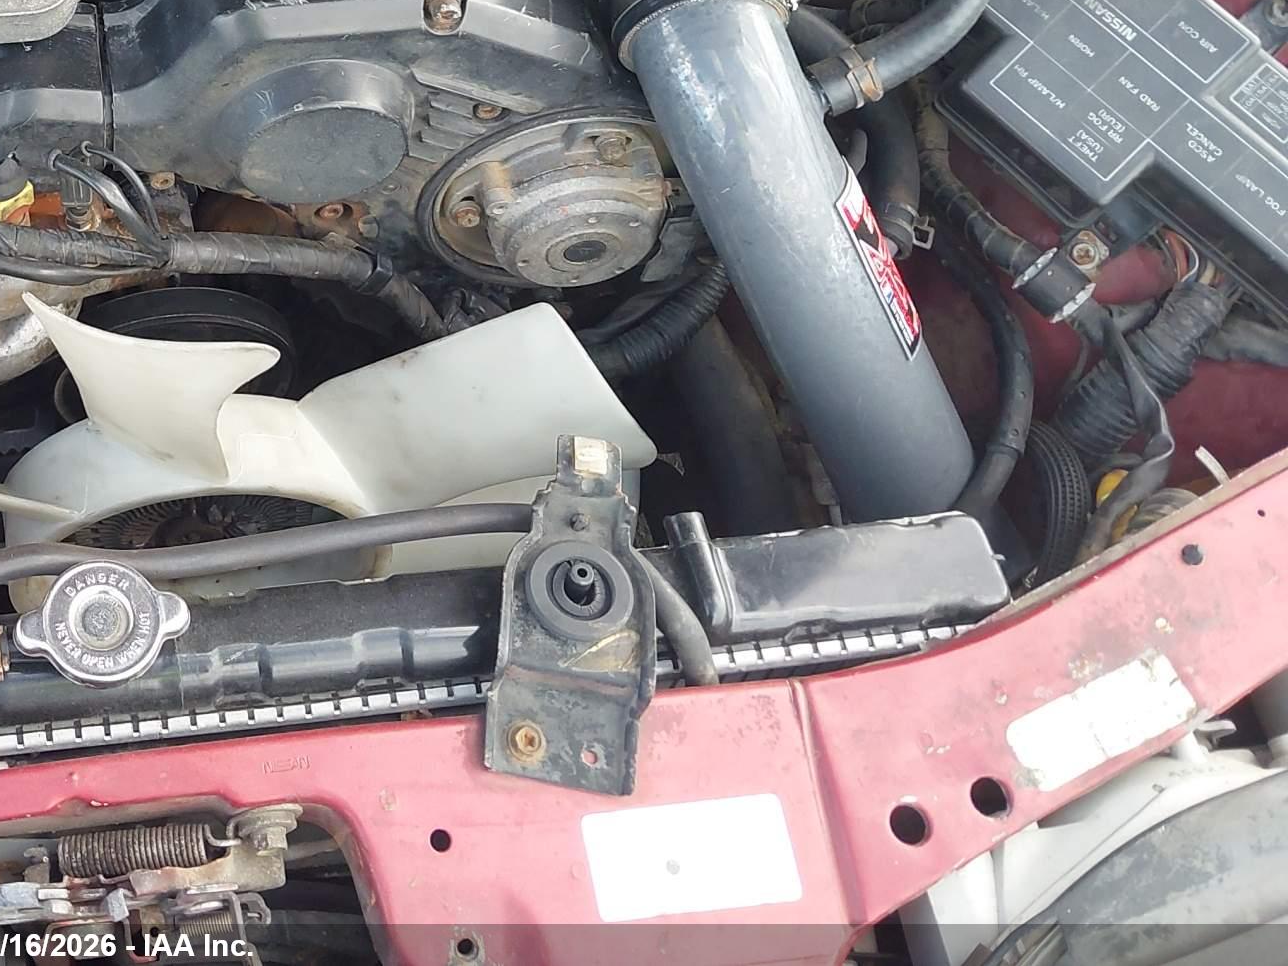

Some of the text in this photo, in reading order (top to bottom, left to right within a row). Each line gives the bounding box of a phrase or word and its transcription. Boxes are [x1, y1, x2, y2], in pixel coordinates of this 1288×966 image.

[1068, 34, 1095, 58] HORN
[1177, 20, 1219, 54] AIR CON
[1013, 64, 1067, 109] H/LAMP RH
[1117, 76, 1161, 112] RAD FAN
[1087, 111, 1124, 144] RR FOG
[1097, 108, 1126, 133] (EUR)
[1067, 135, 1099, 163] THEFT
[1076, 129, 1104, 154] (USA)
[1185, 122, 1223, 157] CANCEL
[1187, 139, 1217, 163] ASCD
[1264, 196, 1287, 216] FOG
[63, 573, 130, 597] DANGER
[55, 621, 82, 659] NEVER
[81, 653, 114, 668] OPEN
[116, 637, 146, 665] WHEN
[139, 611, 150, 635] HOT
